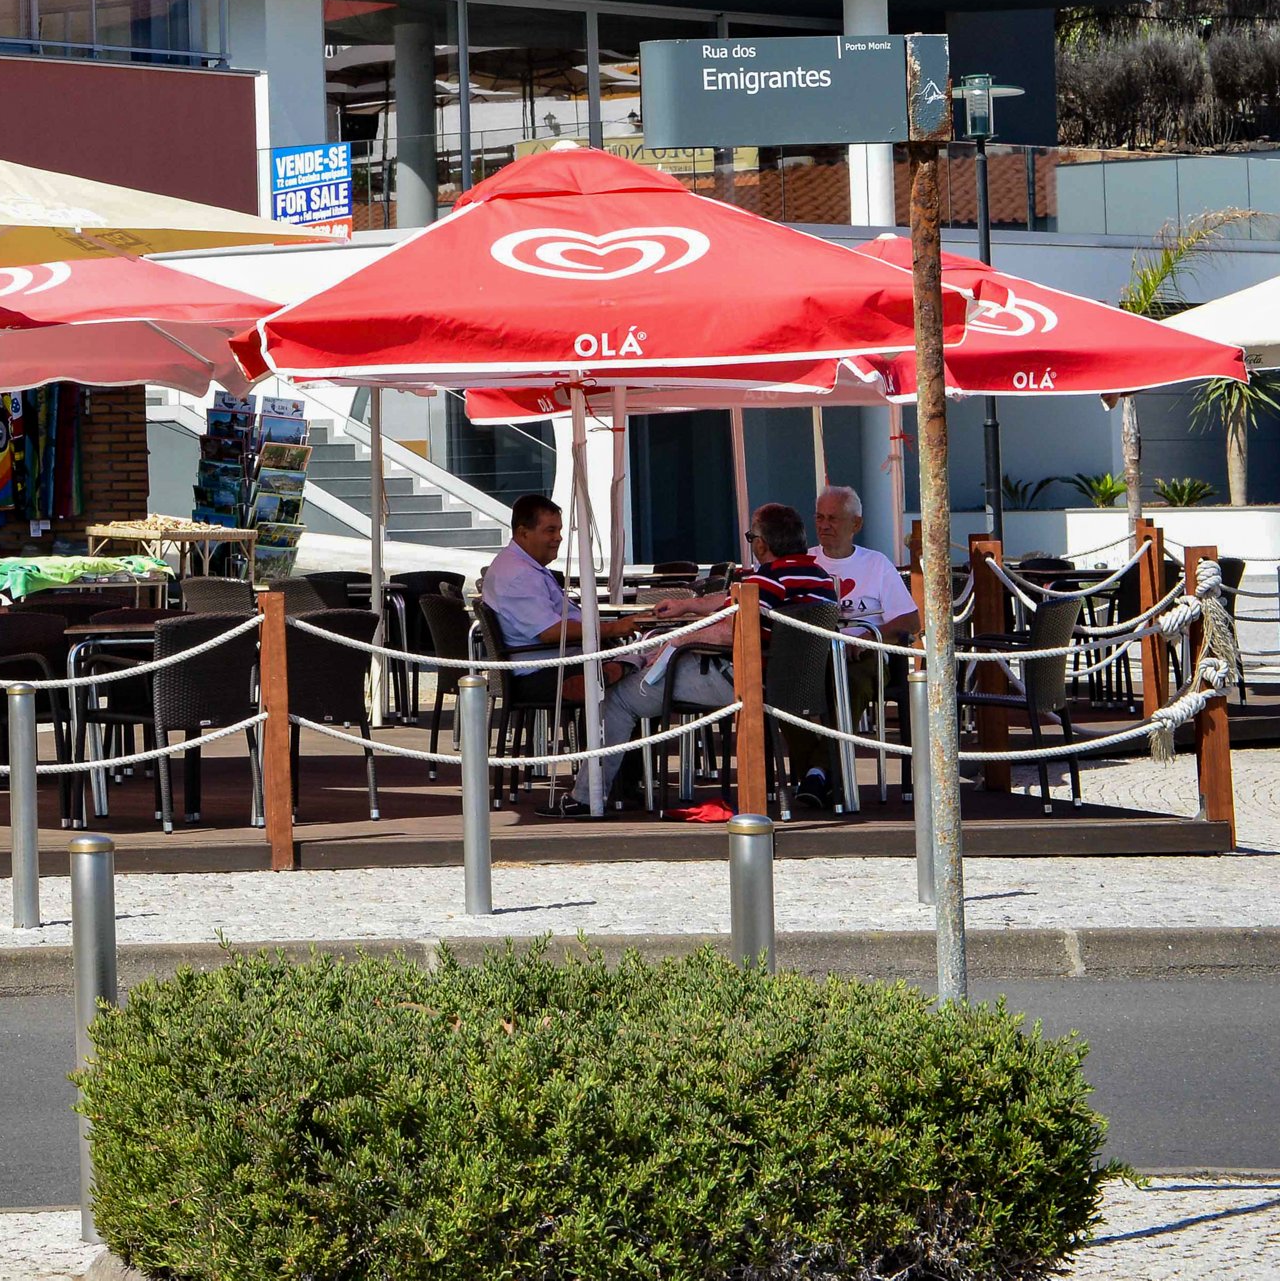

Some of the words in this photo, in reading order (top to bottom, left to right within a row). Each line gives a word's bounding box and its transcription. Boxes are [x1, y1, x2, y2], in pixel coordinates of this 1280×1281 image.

[702, 45, 728, 59] Rua
[732, 44, 756, 58] dos
[845, 43, 867, 52] Porto
[869, 41, 891, 51] Moniz
[703, 66, 832, 95] Emigrantes
[276, 145, 347, 178] VENDE-SE
[277, 190, 307, 215] FOR
[310, 183, 348, 210] SALE
